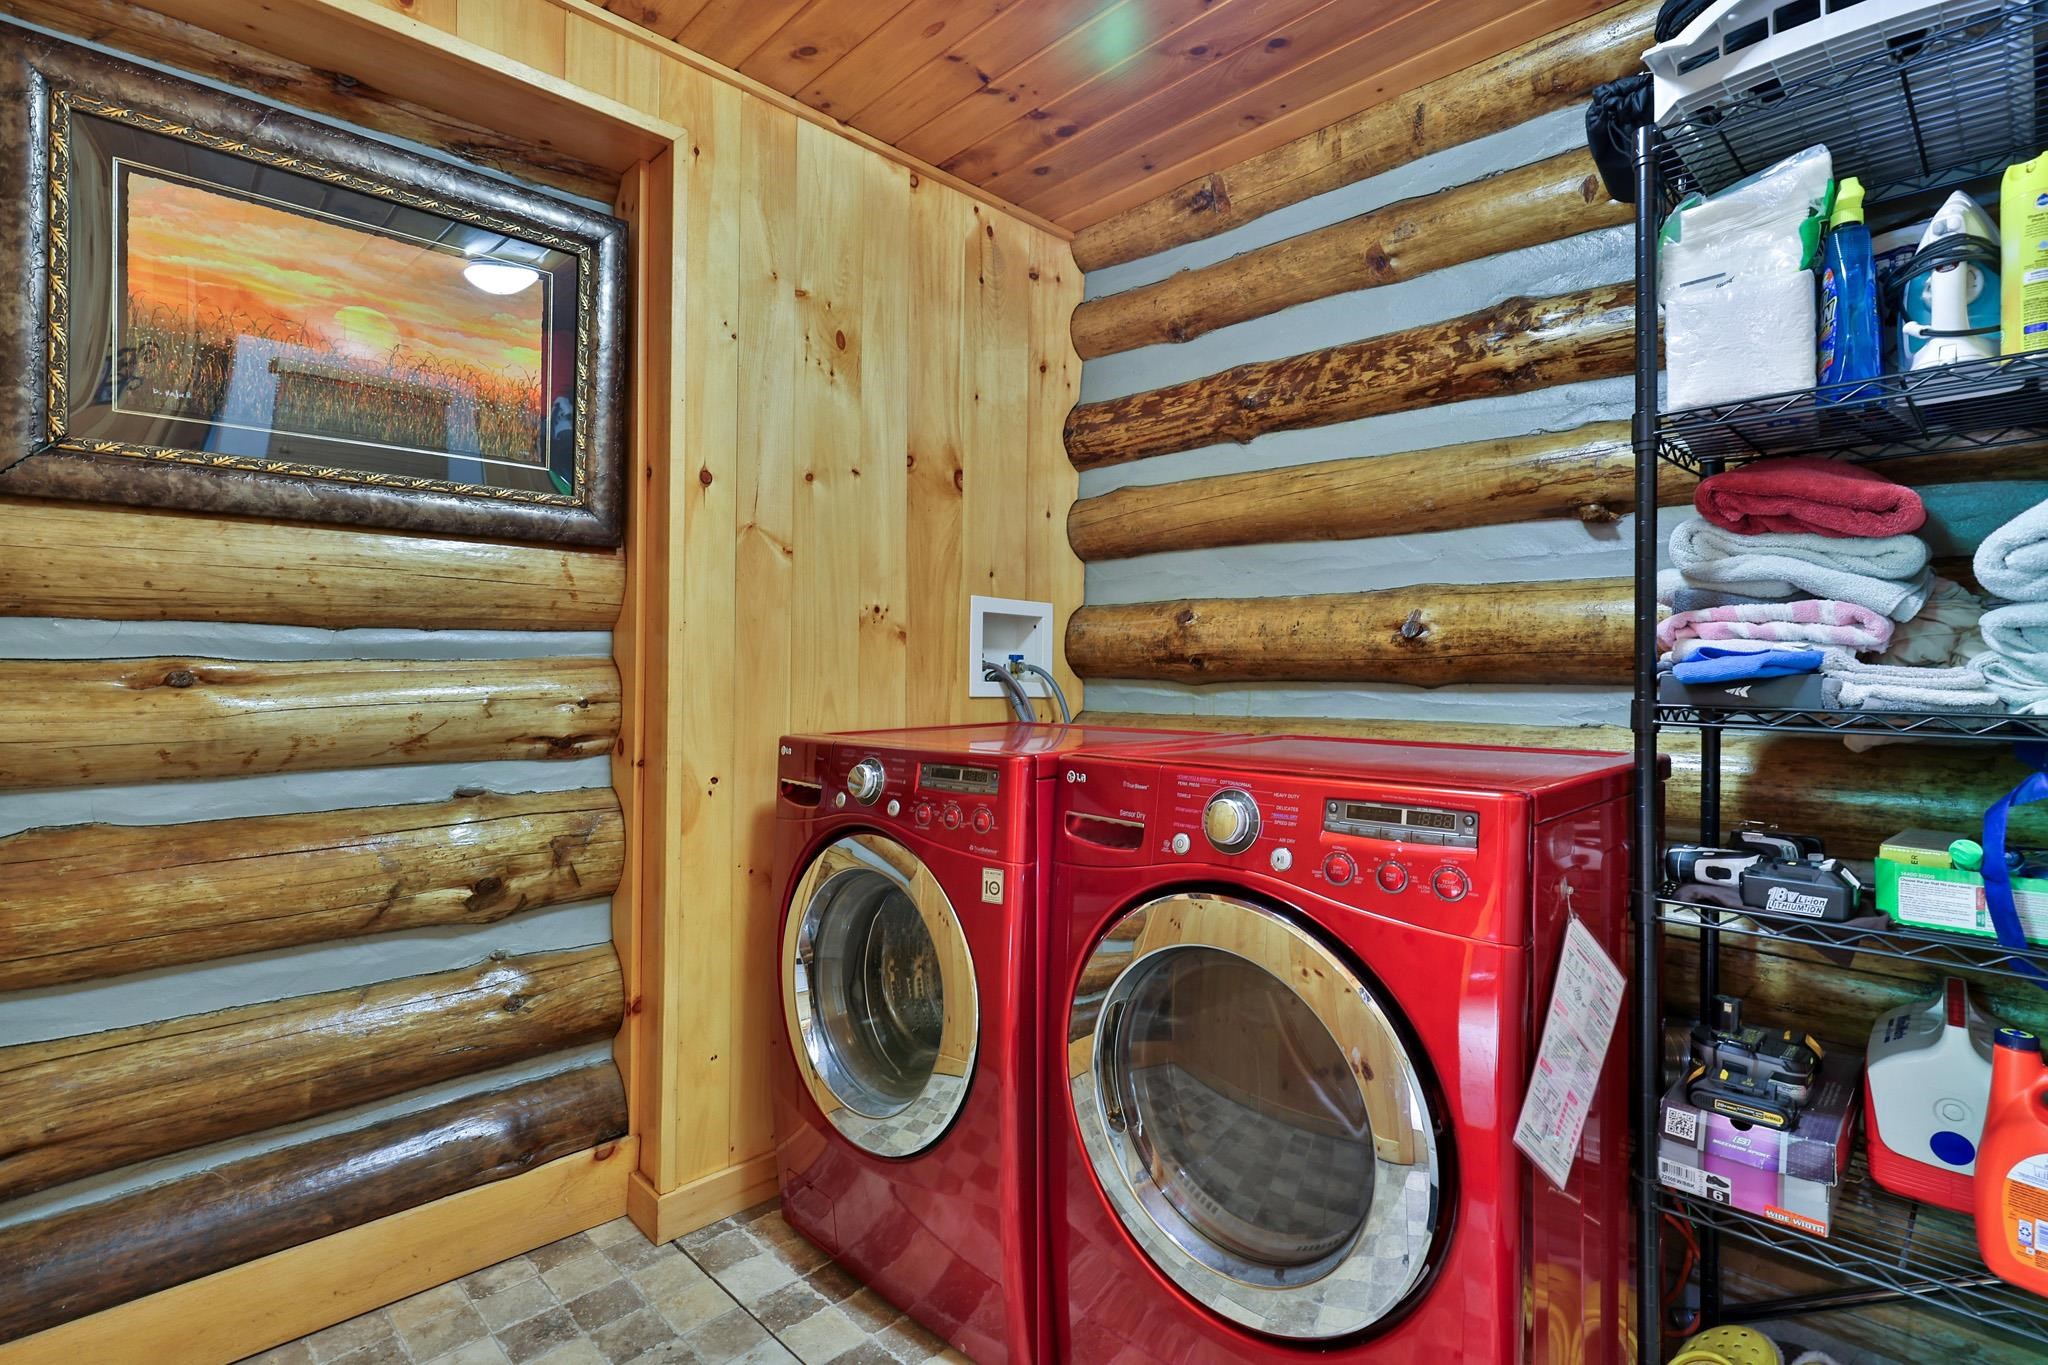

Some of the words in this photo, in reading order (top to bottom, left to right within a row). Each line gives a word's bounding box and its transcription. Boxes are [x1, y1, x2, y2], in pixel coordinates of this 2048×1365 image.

[985, 880, 1001, 896] 10
[1768, 886, 1800, 903] 18V
[1798, 895, 1826, 906] Li-ion
[1712, 1190, 1724, 1202] 6
[1765, 1209, 1790, 1222] WIDE
[1792, 1217, 1825, 1234] WIDTH
